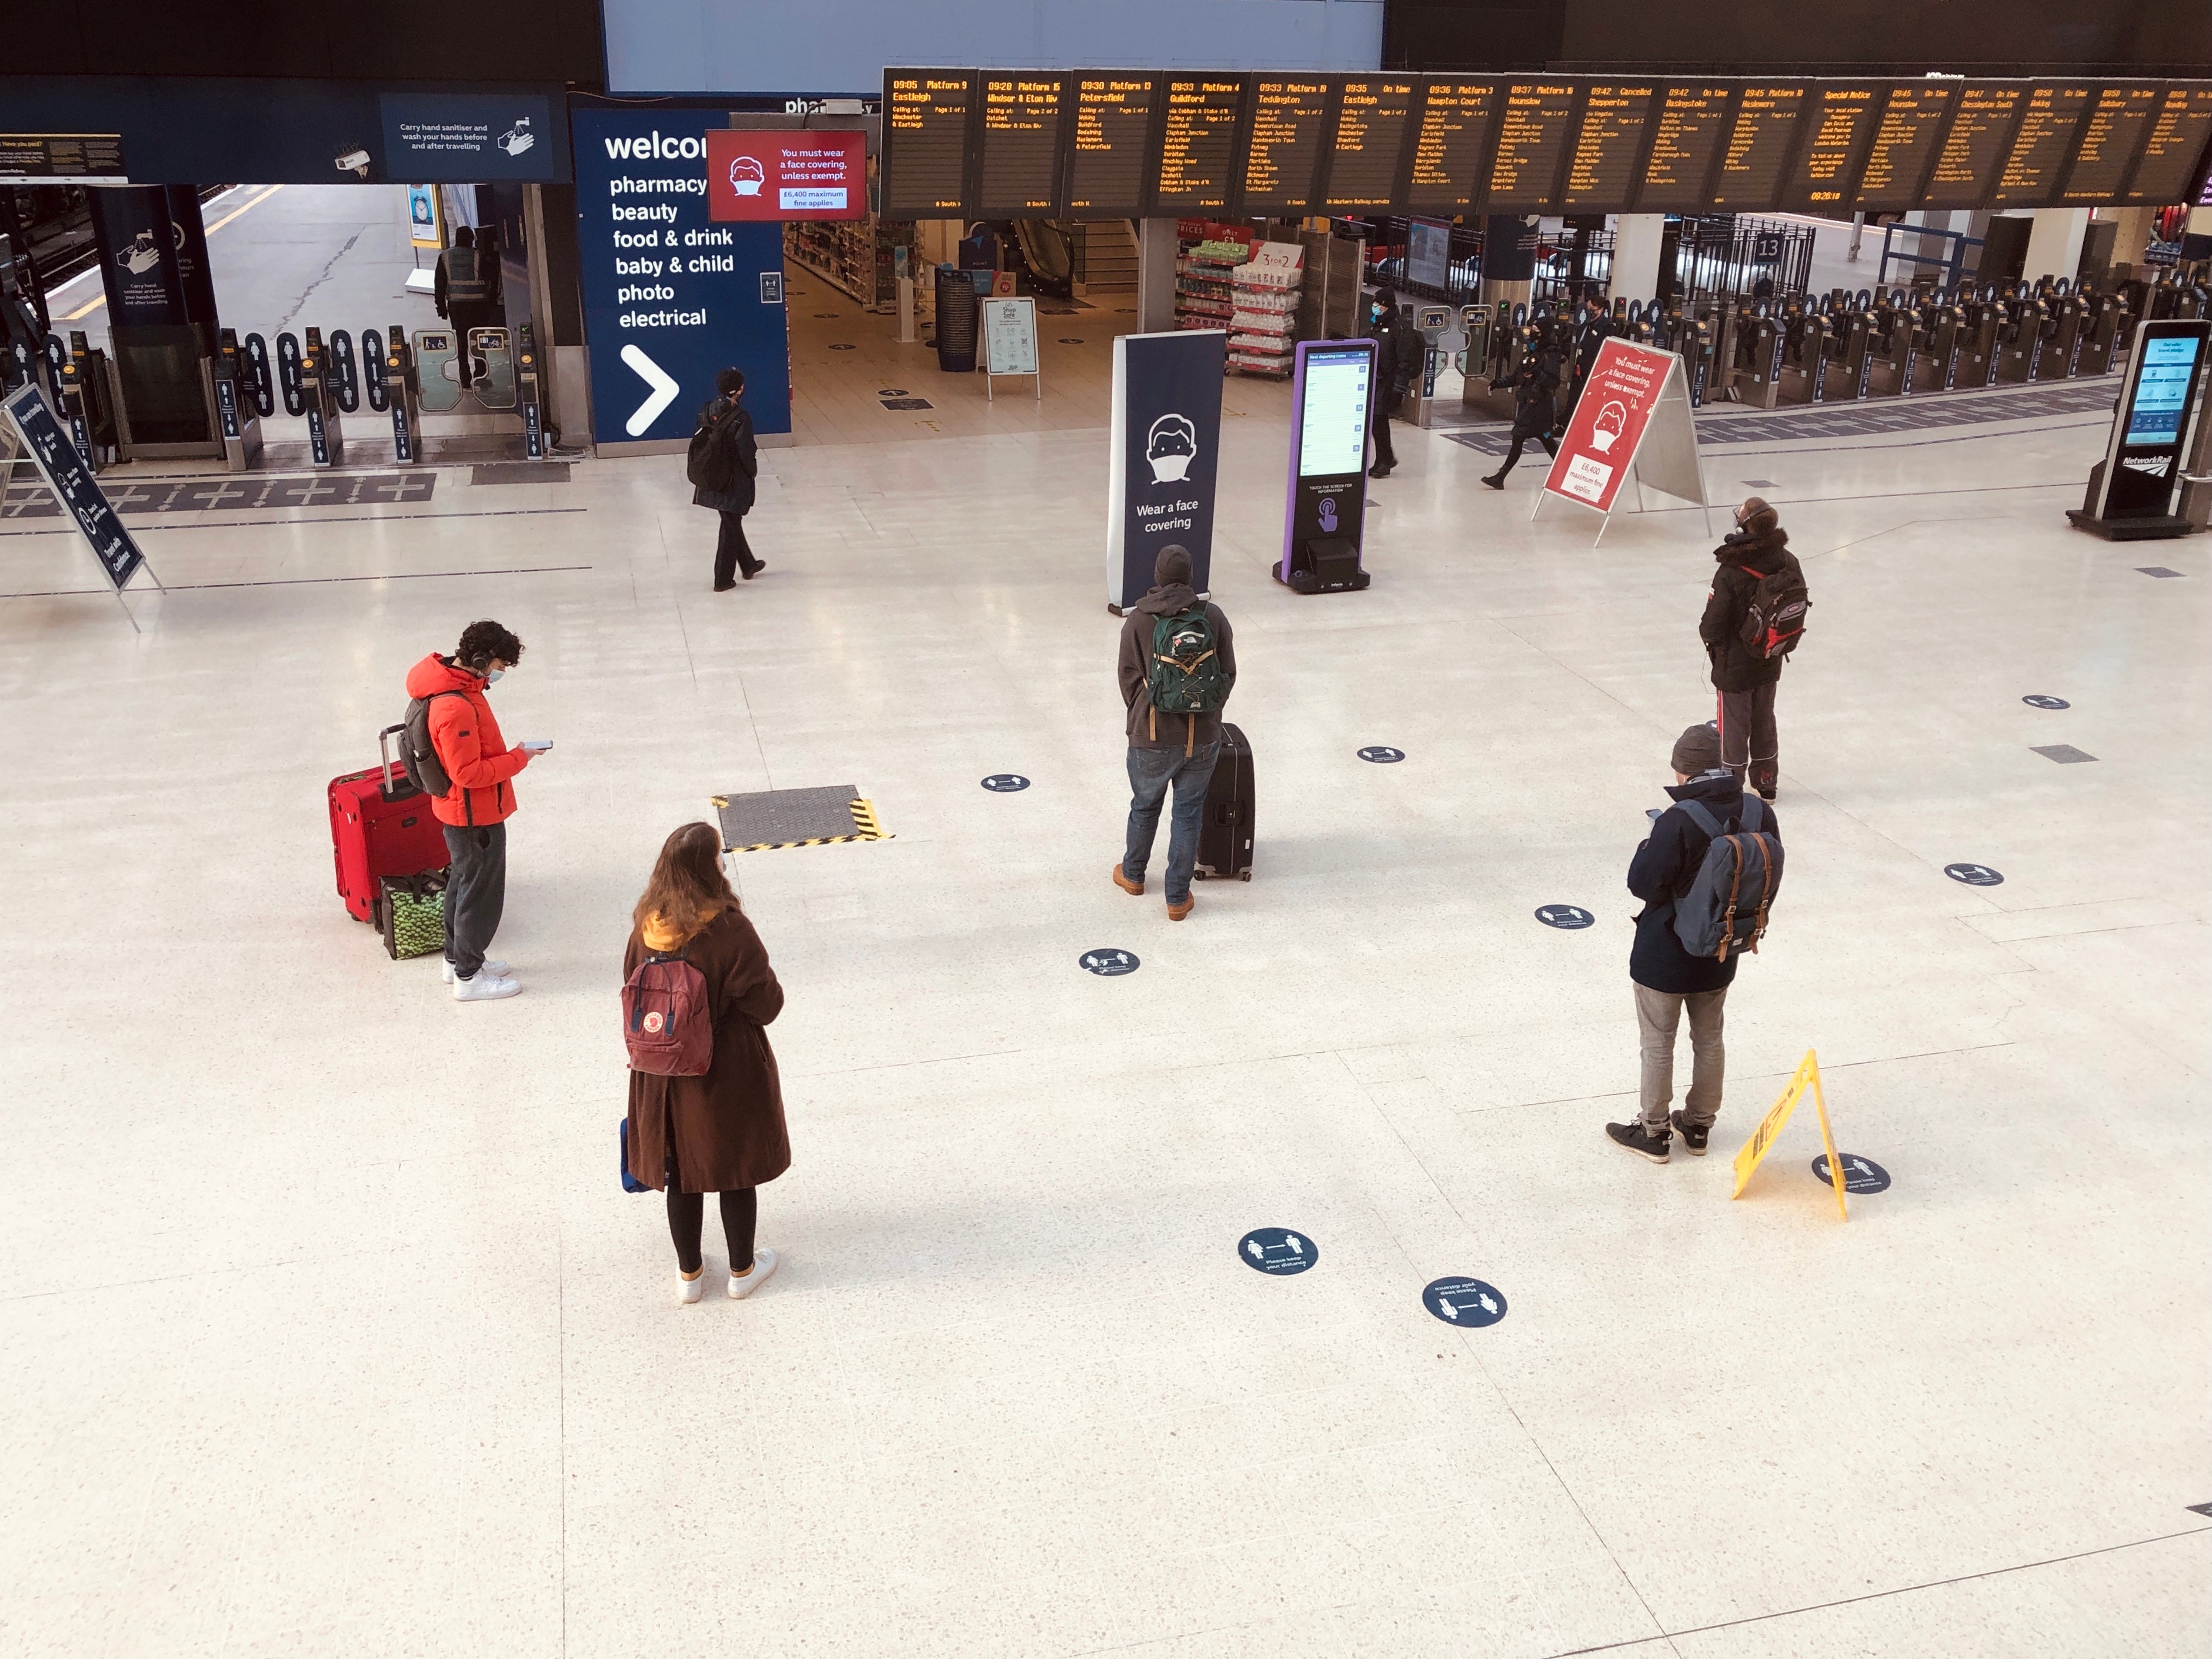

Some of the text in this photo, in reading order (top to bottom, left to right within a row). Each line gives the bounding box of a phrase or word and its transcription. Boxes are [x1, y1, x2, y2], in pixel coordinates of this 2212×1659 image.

[893, 81, 967, 90] 09:05 Platform 9
[988, 82, 1060, 91] 09:28 Platform 15
[1081, 81, 1151, 91] 09:30 Platform 13
[1171, 82, 1239, 92] 09:33 Platform 4
[1259, 84, 1282, 92] 09:33
[1287, 84, 1316, 92] Platform
[1346, 84, 1368, 92] 09:35
[1383, 85, 1392, 93] On
[1458, 86, 1486, 95] Platform
[893, 92, 931, 102] Eastleigh
[1620, 88, 1652, 96] Cancelled
[1824, 91, 1847, 99] Special
[987, 94, 1015, 102] Windsor
[1026, 94, 1043, 102] Eton
[1080, 94, 1125, 102] Petersfield
[1170, 94, 1205, 103] Guildford
[1259, 95, 1300, 104] Teddington
[1343, 95, 1377, 104] Eastleigh
[1427, 97, 1481, 105] Hampton Court
[1509, 97, 1540, 105] Hounslow
[1666, 99, 1707, 108] Basingstoke
[1741, 100, 1775, 108] Haslemere
[400, 123, 421, 132] Carry
[446, 143, 481, 151] travelling
[605, 130, 707, 159] welco
[788, 160, 805, 168] face
[807, 161, 847, 170] covering,
[781, 172, 846, 181] unless exempt.
[610, 176, 707, 196] pharmacy
[612, 203, 678, 223] beauty
[613, 229, 734, 248] food & drink
[1759, 239, 1779, 257] 13
[1263, 254, 1270, 266] 3
[1282, 256, 1289, 267] 2
[616, 255, 734, 277] baby & child
[618, 283, 675, 304] photo
[619, 308, 707, 328] electrical
[1615, 356, 1656, 374] You must wear
[1613, 369, 1626, 379] face
[1625, 375, 1651, 388] covering,
[1604, 380, 1645, 398] unless exempt.
[2123, 455, 2173, 465] NetworkRail
[1581, 462, 1600, 476] £6,400
[1569, 470, 1603, 488] maximum fine
[1574, 483, 1590, 495] applies
[1137, 499, 1199, 516] Wear a face
[1145, 518, 1191, 532] covering
[1281, 1260, 1307, 1269] distance
